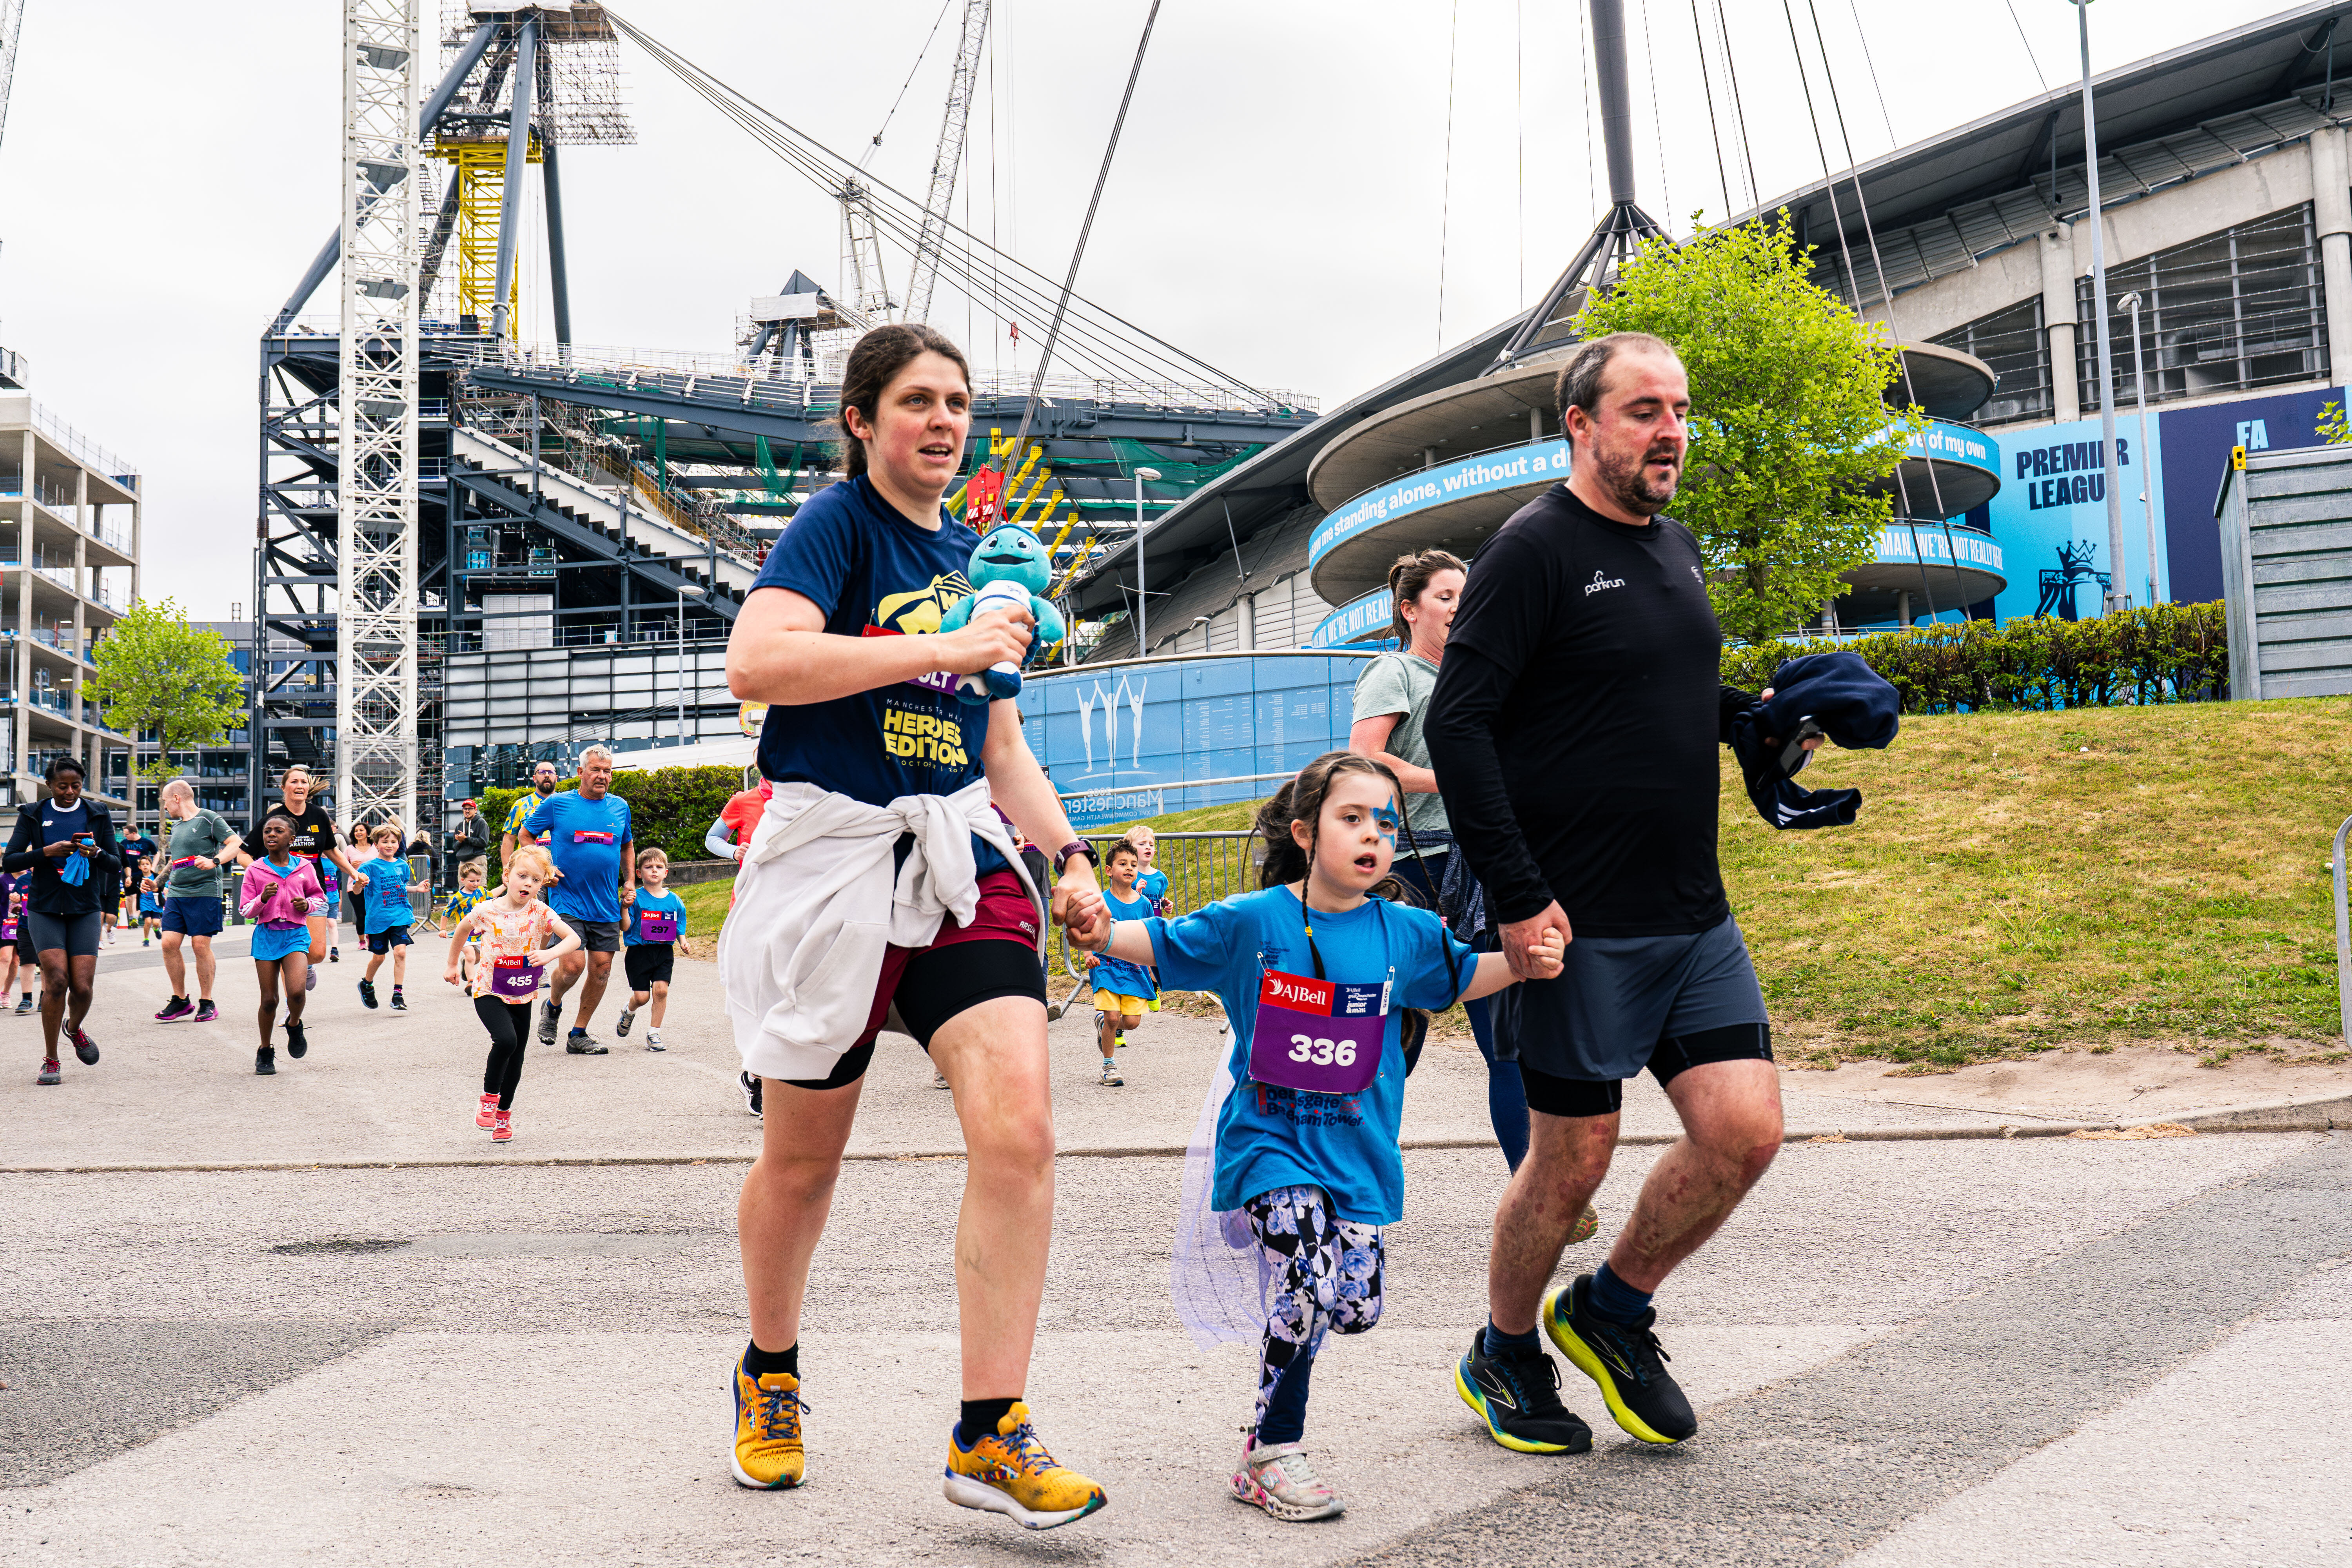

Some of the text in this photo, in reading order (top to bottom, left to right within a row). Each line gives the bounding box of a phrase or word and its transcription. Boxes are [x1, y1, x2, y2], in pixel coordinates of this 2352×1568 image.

[1929, 430, 1943, 450] of
[1945, 437, 1964, 458] my
[1966, 441, 1986, 460] own
[2236, 419, 2269, 450] FA
[2016, 438, 2129, 480] PREMIR
[1321, 527, 1334, 547] me
[1334, 498, 1387, 536] standing
[1388, 487, 1441, 511] alone,
[1443, 456, 1528, 492] without
[1532, 454, 1547, 472] a
[2029, 473, 2105, 510] LEAGU
[1879, 532, 1915, 560] MAN,
[1916, 532, 1951, 559] WE'RE
[1953, 536, 1969, 561] NOT
[1970, 539, 1992, 566] REALLY
[1992, 545, 2003, 571] HERE
[1585, 577, 1625, 596] parkrun
[1327, 612, 1348, 644] WE'RE
[1348, 605, 1365, 633] NOT
[887, 699, 943, 715] MANCHESTR
[507, 975, 533, 987] 455
[1281, 985, 1326, 1005] AJBell
[1288, 1034, 1357, 1067] 336
